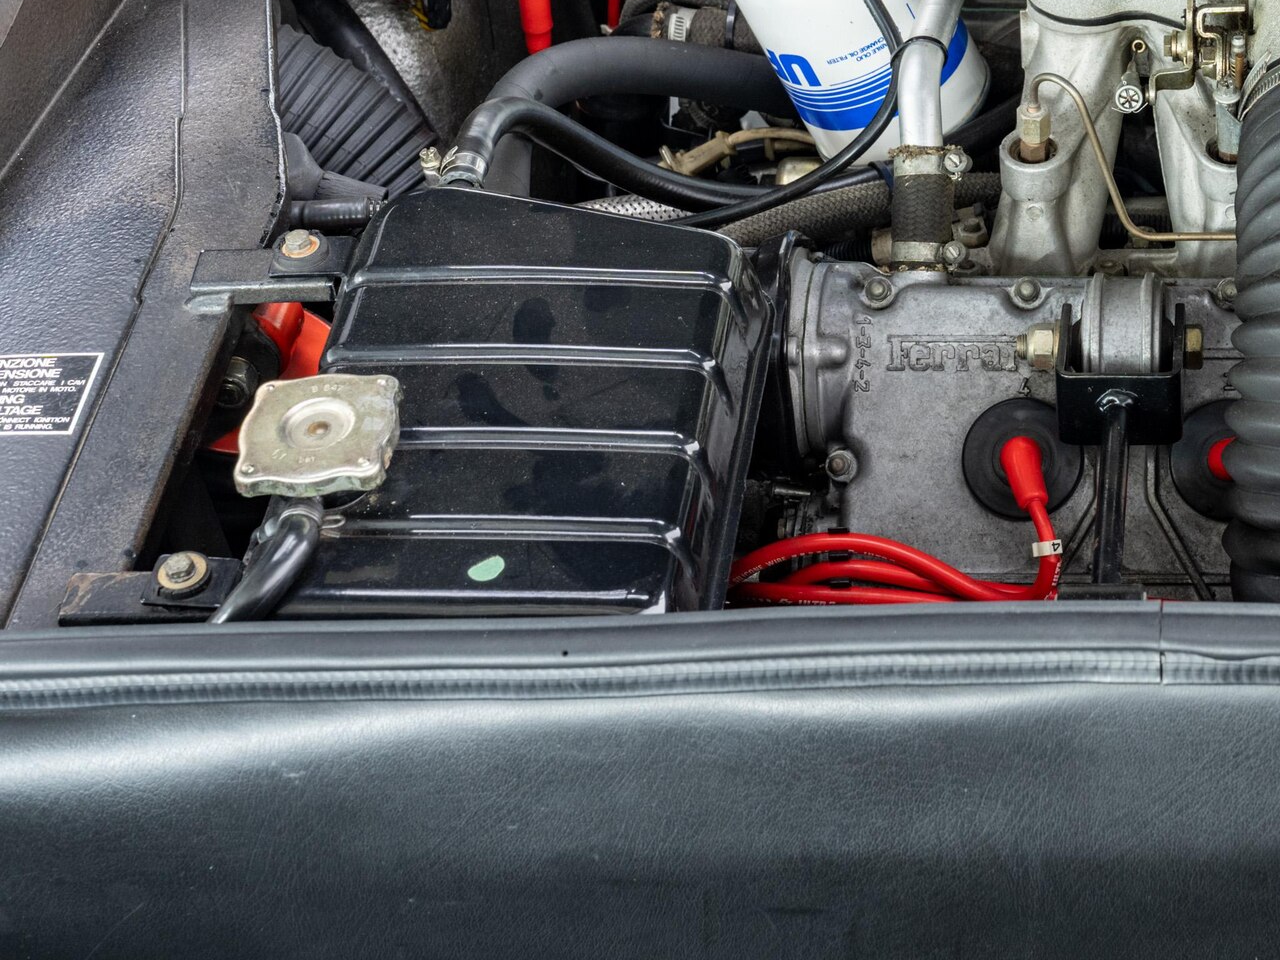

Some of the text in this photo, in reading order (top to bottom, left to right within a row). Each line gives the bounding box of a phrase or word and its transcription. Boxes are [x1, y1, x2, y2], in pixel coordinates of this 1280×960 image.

[826, 55, 849, 65] FILTER
[856, 51, 872, 62] OLIO
[886, 334, 1019, 372] Ferrar
[0, 358, 57, 369] NZIONE
[1017, 377, 1032, 397] 4
[1052, 542, 1060, 552] 4
[766, 556, 787, 567] WIRE
